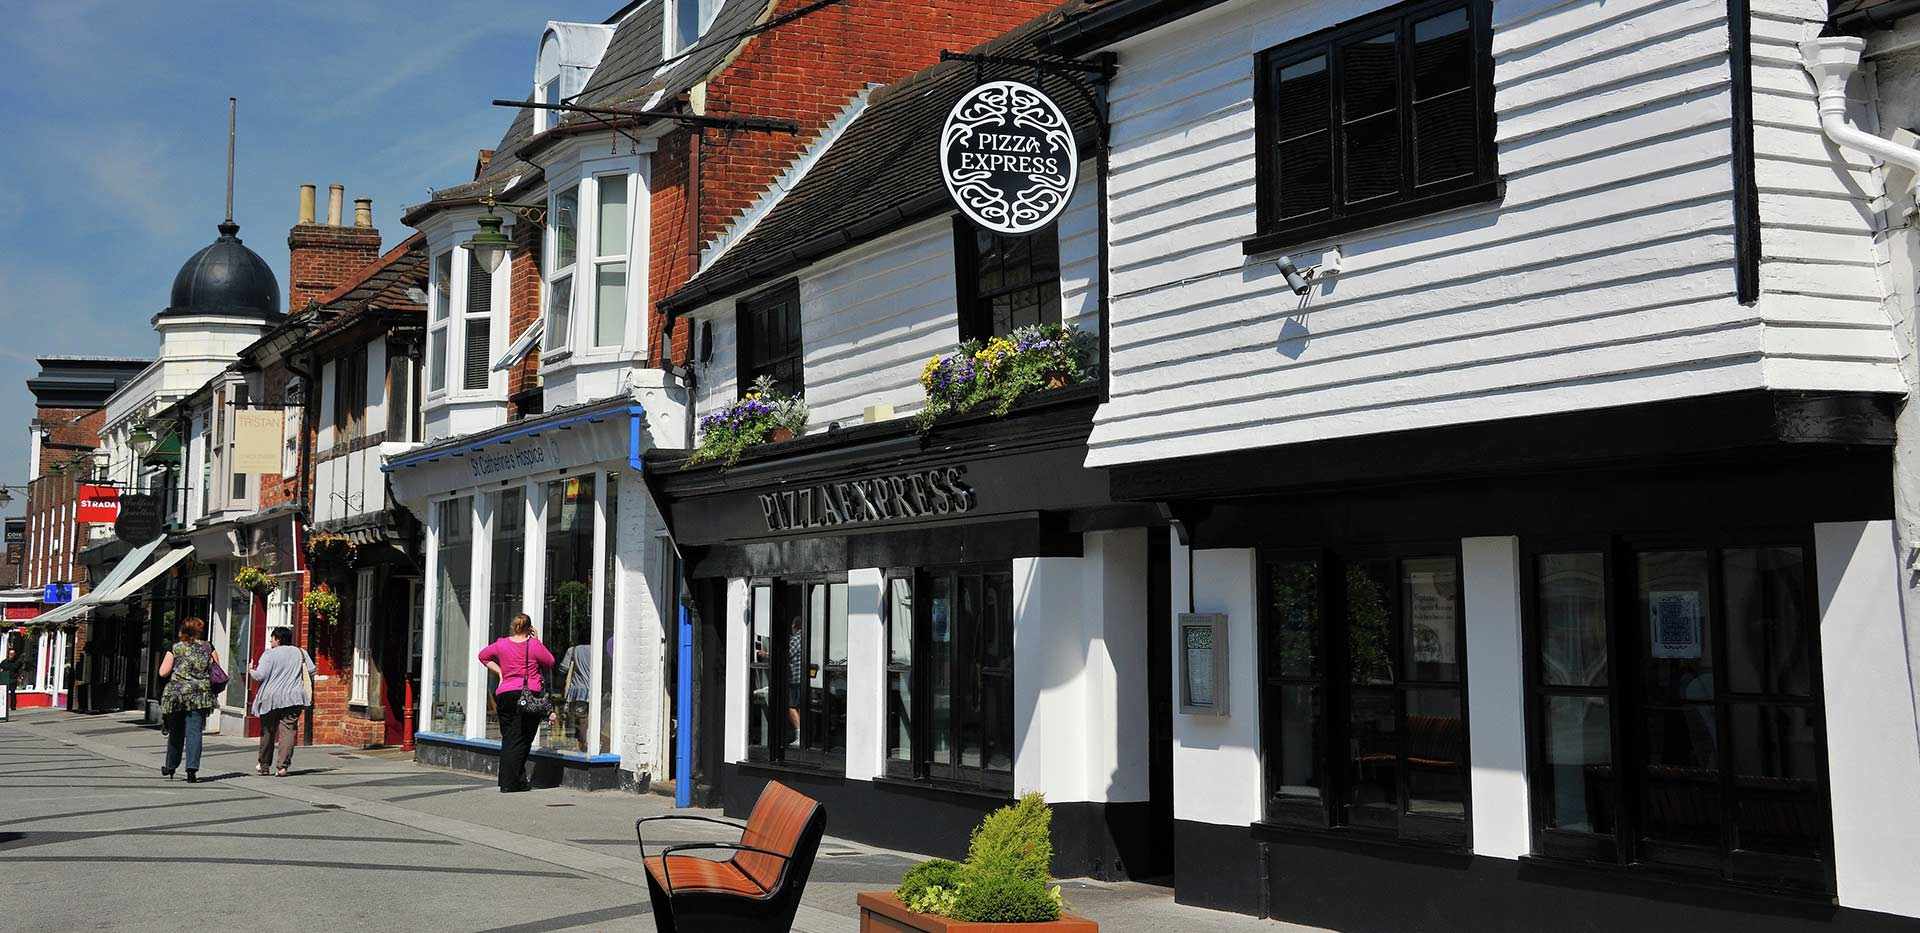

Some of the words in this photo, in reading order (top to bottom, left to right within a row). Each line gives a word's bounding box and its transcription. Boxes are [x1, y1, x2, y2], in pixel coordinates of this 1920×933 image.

[978, 133, 1041, 153] PIZZA
[960, 152, 1059, 175] EXPRESS
[514, 446, 545, 469] Hospice
[80, 500, 117, 509] STRADA
